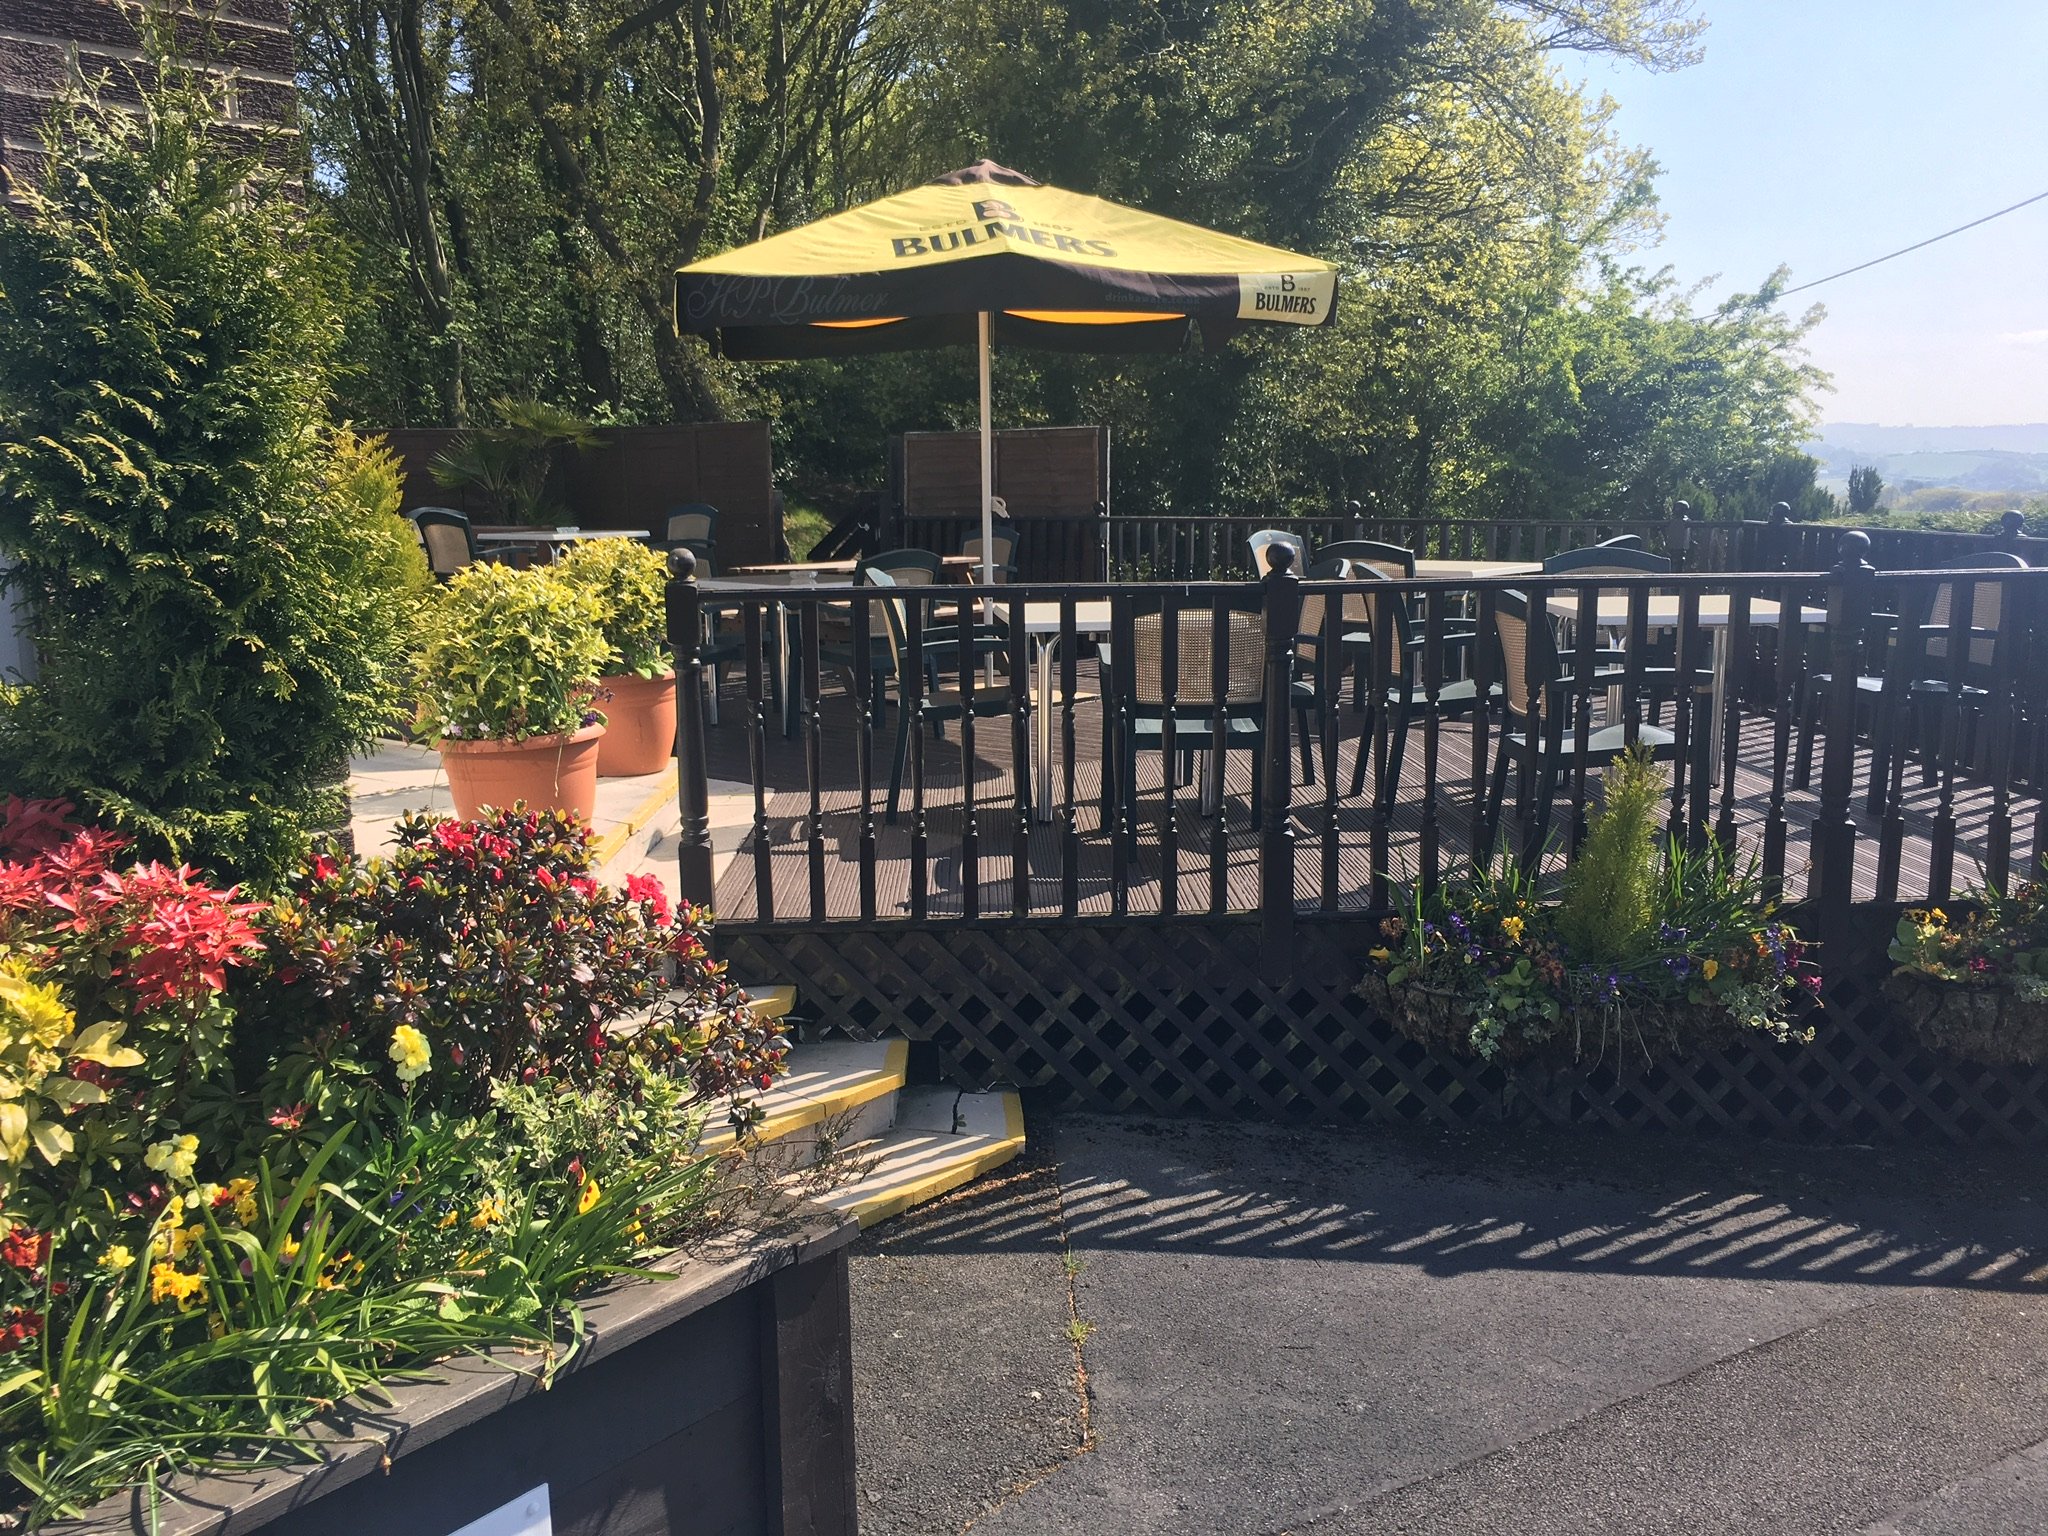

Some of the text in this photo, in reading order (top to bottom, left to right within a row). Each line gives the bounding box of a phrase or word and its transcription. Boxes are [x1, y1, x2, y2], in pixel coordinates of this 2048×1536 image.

[892, 221, 1118, 257] BULMERS
[1281, 274, 1296, 292] B
[1255, 292, 1316, 315] BULMERS
